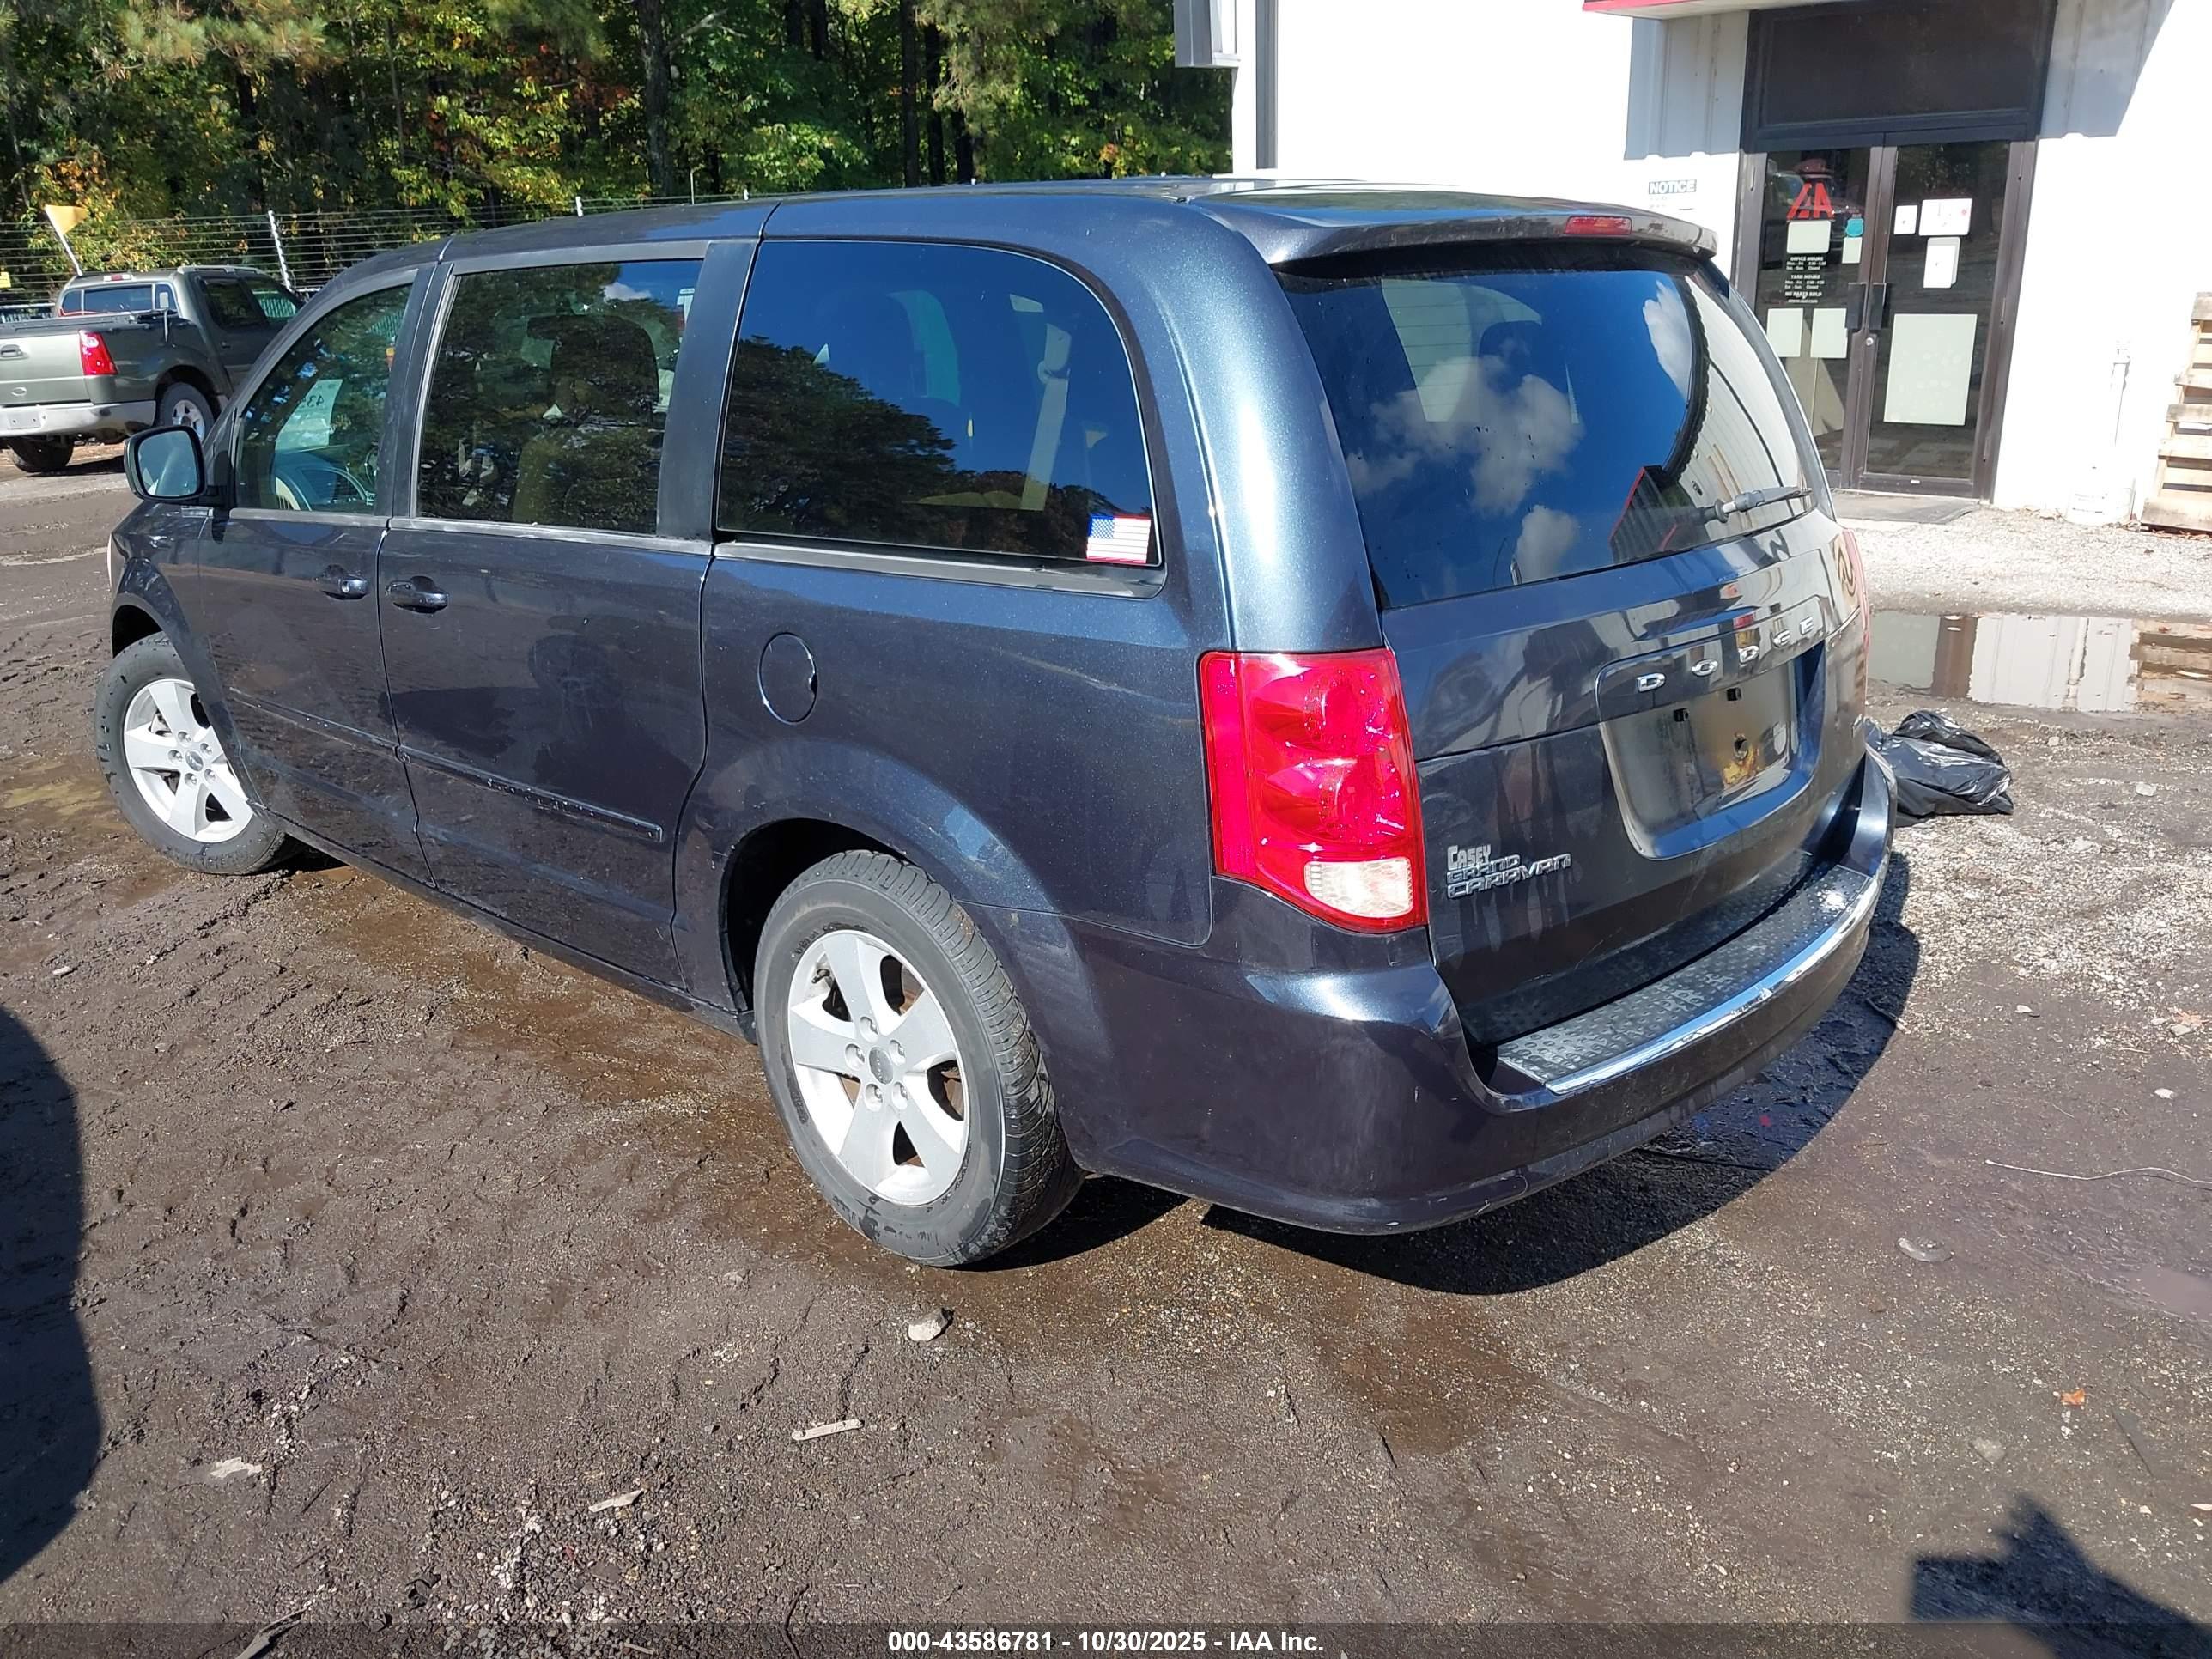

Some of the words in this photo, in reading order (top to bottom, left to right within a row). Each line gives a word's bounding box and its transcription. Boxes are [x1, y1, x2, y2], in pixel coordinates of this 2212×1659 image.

[1650, 179, 1696, 194] NOTICE
[1636, 617, 1815, 693] DODGE
[1446, 854, 1521, 884] GRAND
[1447, 853, 1571, 899] CARAVAN
